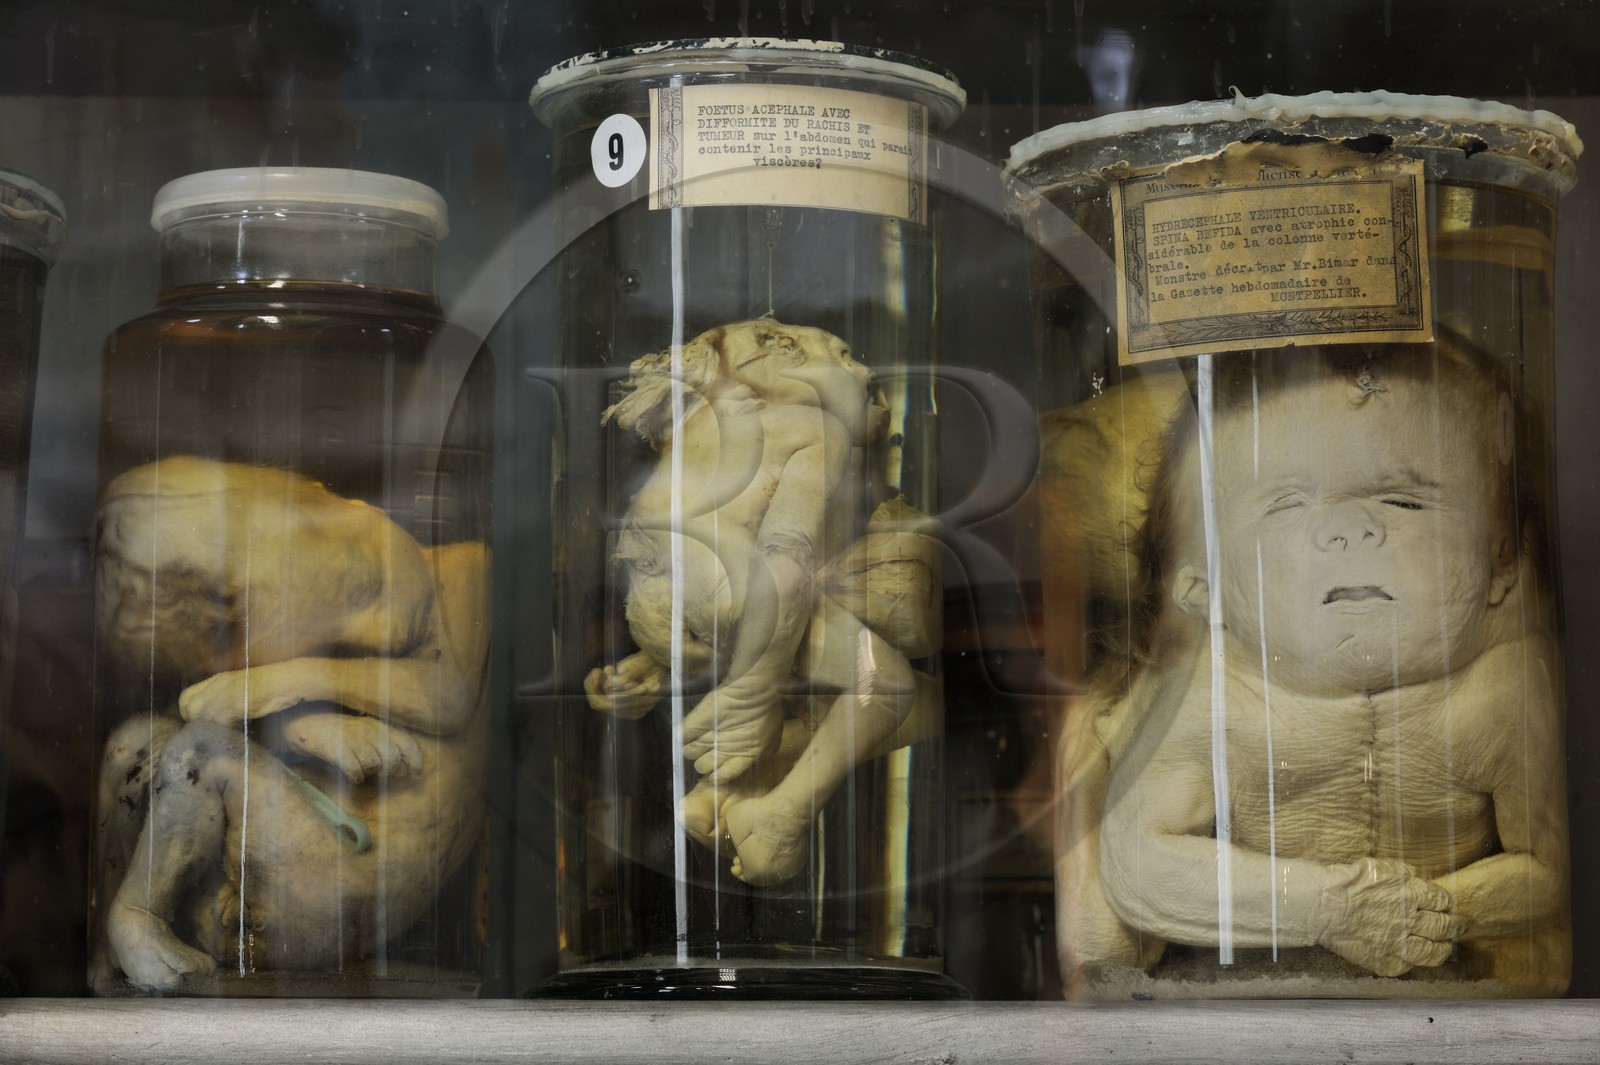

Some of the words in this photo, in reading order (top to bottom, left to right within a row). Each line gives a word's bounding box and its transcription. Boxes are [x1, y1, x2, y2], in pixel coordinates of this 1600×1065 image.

[697, 105, 744, 116] FOETUS
[751, 105, 815, 117] ACEPHALE
[821, 108, 850, 119] AVEC
[697, 117, 776, 129] DIFFORMITE
[783, 118, 799, 128] DU
[806, 120, 850, 132] RACHIS
[857, 124, 871, 135] ET
[698, 130, 744, 141] TUMEUR
[753, 131, 776, 141] sur
[784, 130, 851, 145] l'abdomen
[858, 138, 876, 149] qui
[608, 132, 624, 171] 9
[698, 143, 761, 155] contenir
[769, 143, 792, 154] les
[800, 145, 871, 161] principaux
[753, 156, 822, 169] viscères?
[1249, 203, 1361, 221] VENTRICULAIRE.
[1153, 230, 1190, 247] SPINA
[1250, 222, 1282, 234] avec
[1291, 217, 1355, 231] atrophie
[1364, 217, 1394, 226] con-
[1148, 242, 1211, 260] sidérable
[1220, 239, 1234, 251] de
[1243, 238, 1260, 248] la
[1268, 232, 1324, 246] colonne
[1332, 228, 1380, 241] verté-
[1148, 260, 1190, 274] brale.
[1155, 270, 1206, 286] Monstre
[1151, 292, 1165, 303] la
[1170, 285, 1224, 300] Gazette
[1231, 276, 1327, 293] hebdomadaire
[1336, 275, 1351, 286] de
[1270, 287, 1367, 303] MONTPELLIER.
